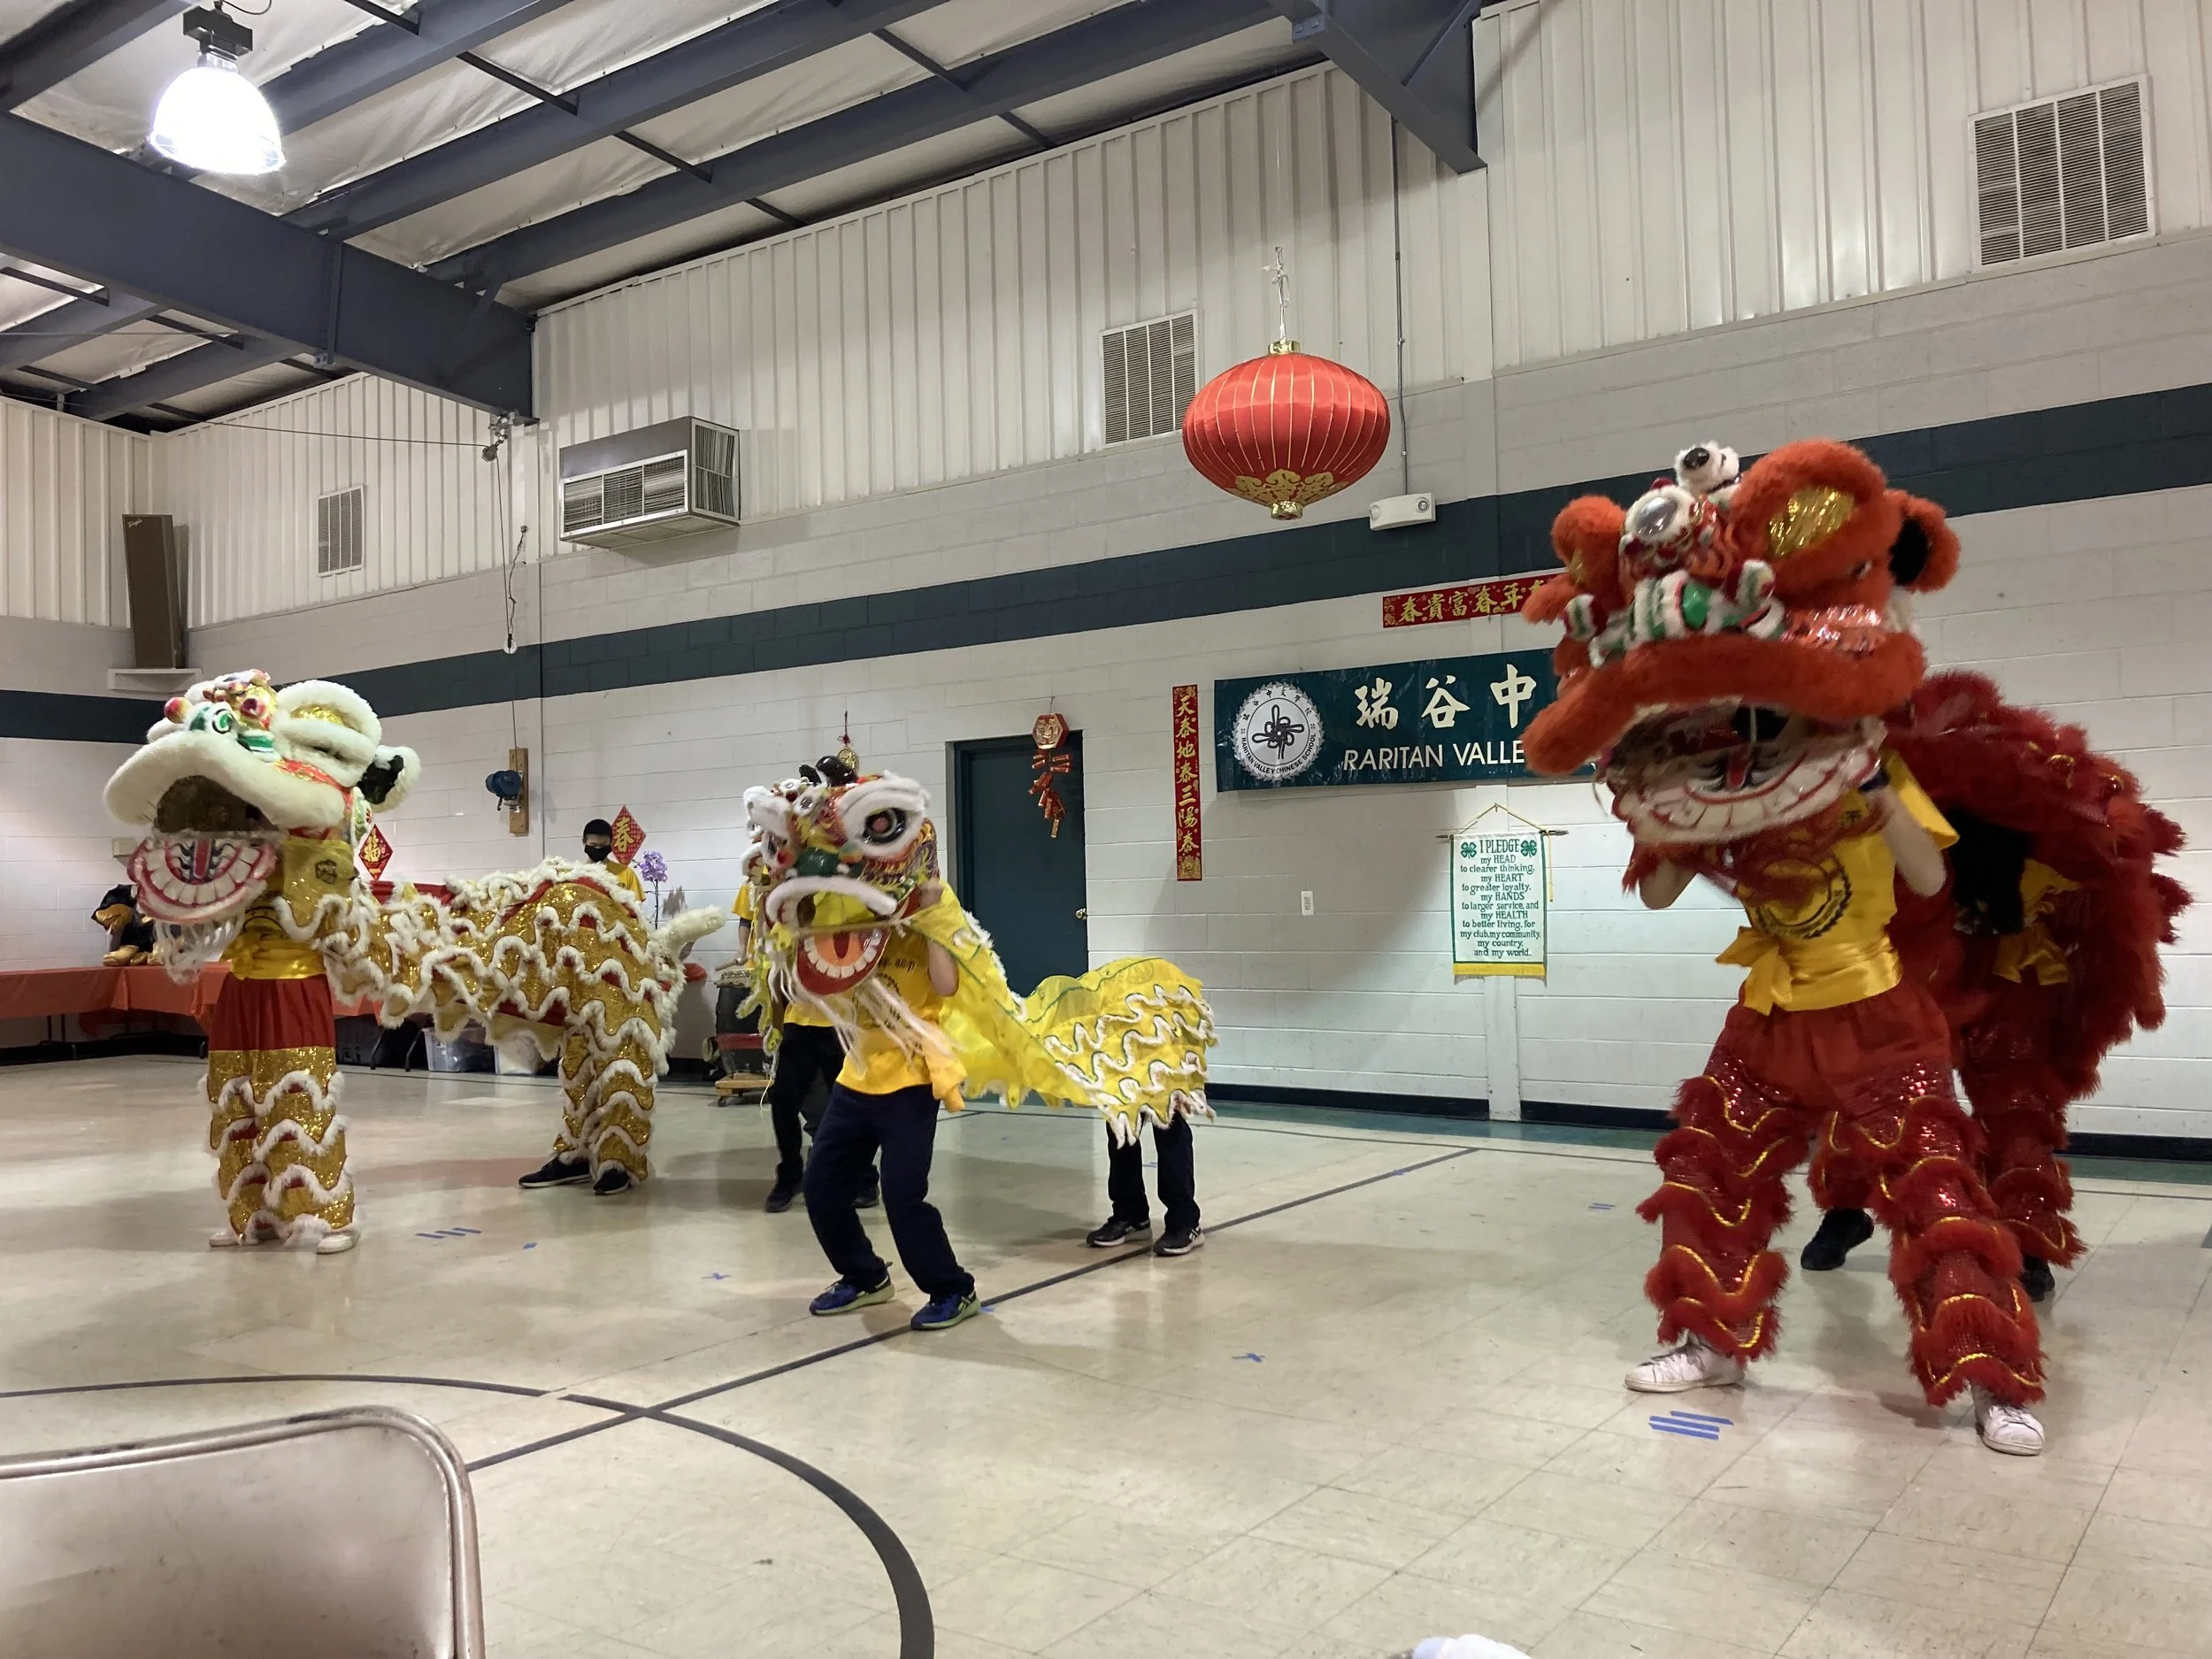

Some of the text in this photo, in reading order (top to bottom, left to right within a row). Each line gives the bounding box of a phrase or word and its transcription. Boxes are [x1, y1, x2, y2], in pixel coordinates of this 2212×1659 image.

[1241, 733, 1316, 774] RARITAN VALLEY CHINESE SCHOOL
[1343, 741, 1525, 771] RARITAN VALLE
[613, 816, 634, 853] 春
[1479, 840, 1484, 853] I
[1485, 839, 1520, 853] PLEDGE
[1480, 855, 1517, 866] my HEAD
[1480, 873, 1524, 885] my HEART
[1470, 884, 1501, 895] greater
[1495, 892, 1525, 901] HANDS
[1470, 902, 1494, 912] larger
[1525, 900, 1539, 909] and
[1495, 910, 1528, 919] HEALTH
[1460, 931, 1472, 940] my
[1492, 949, 1504, 959] my
